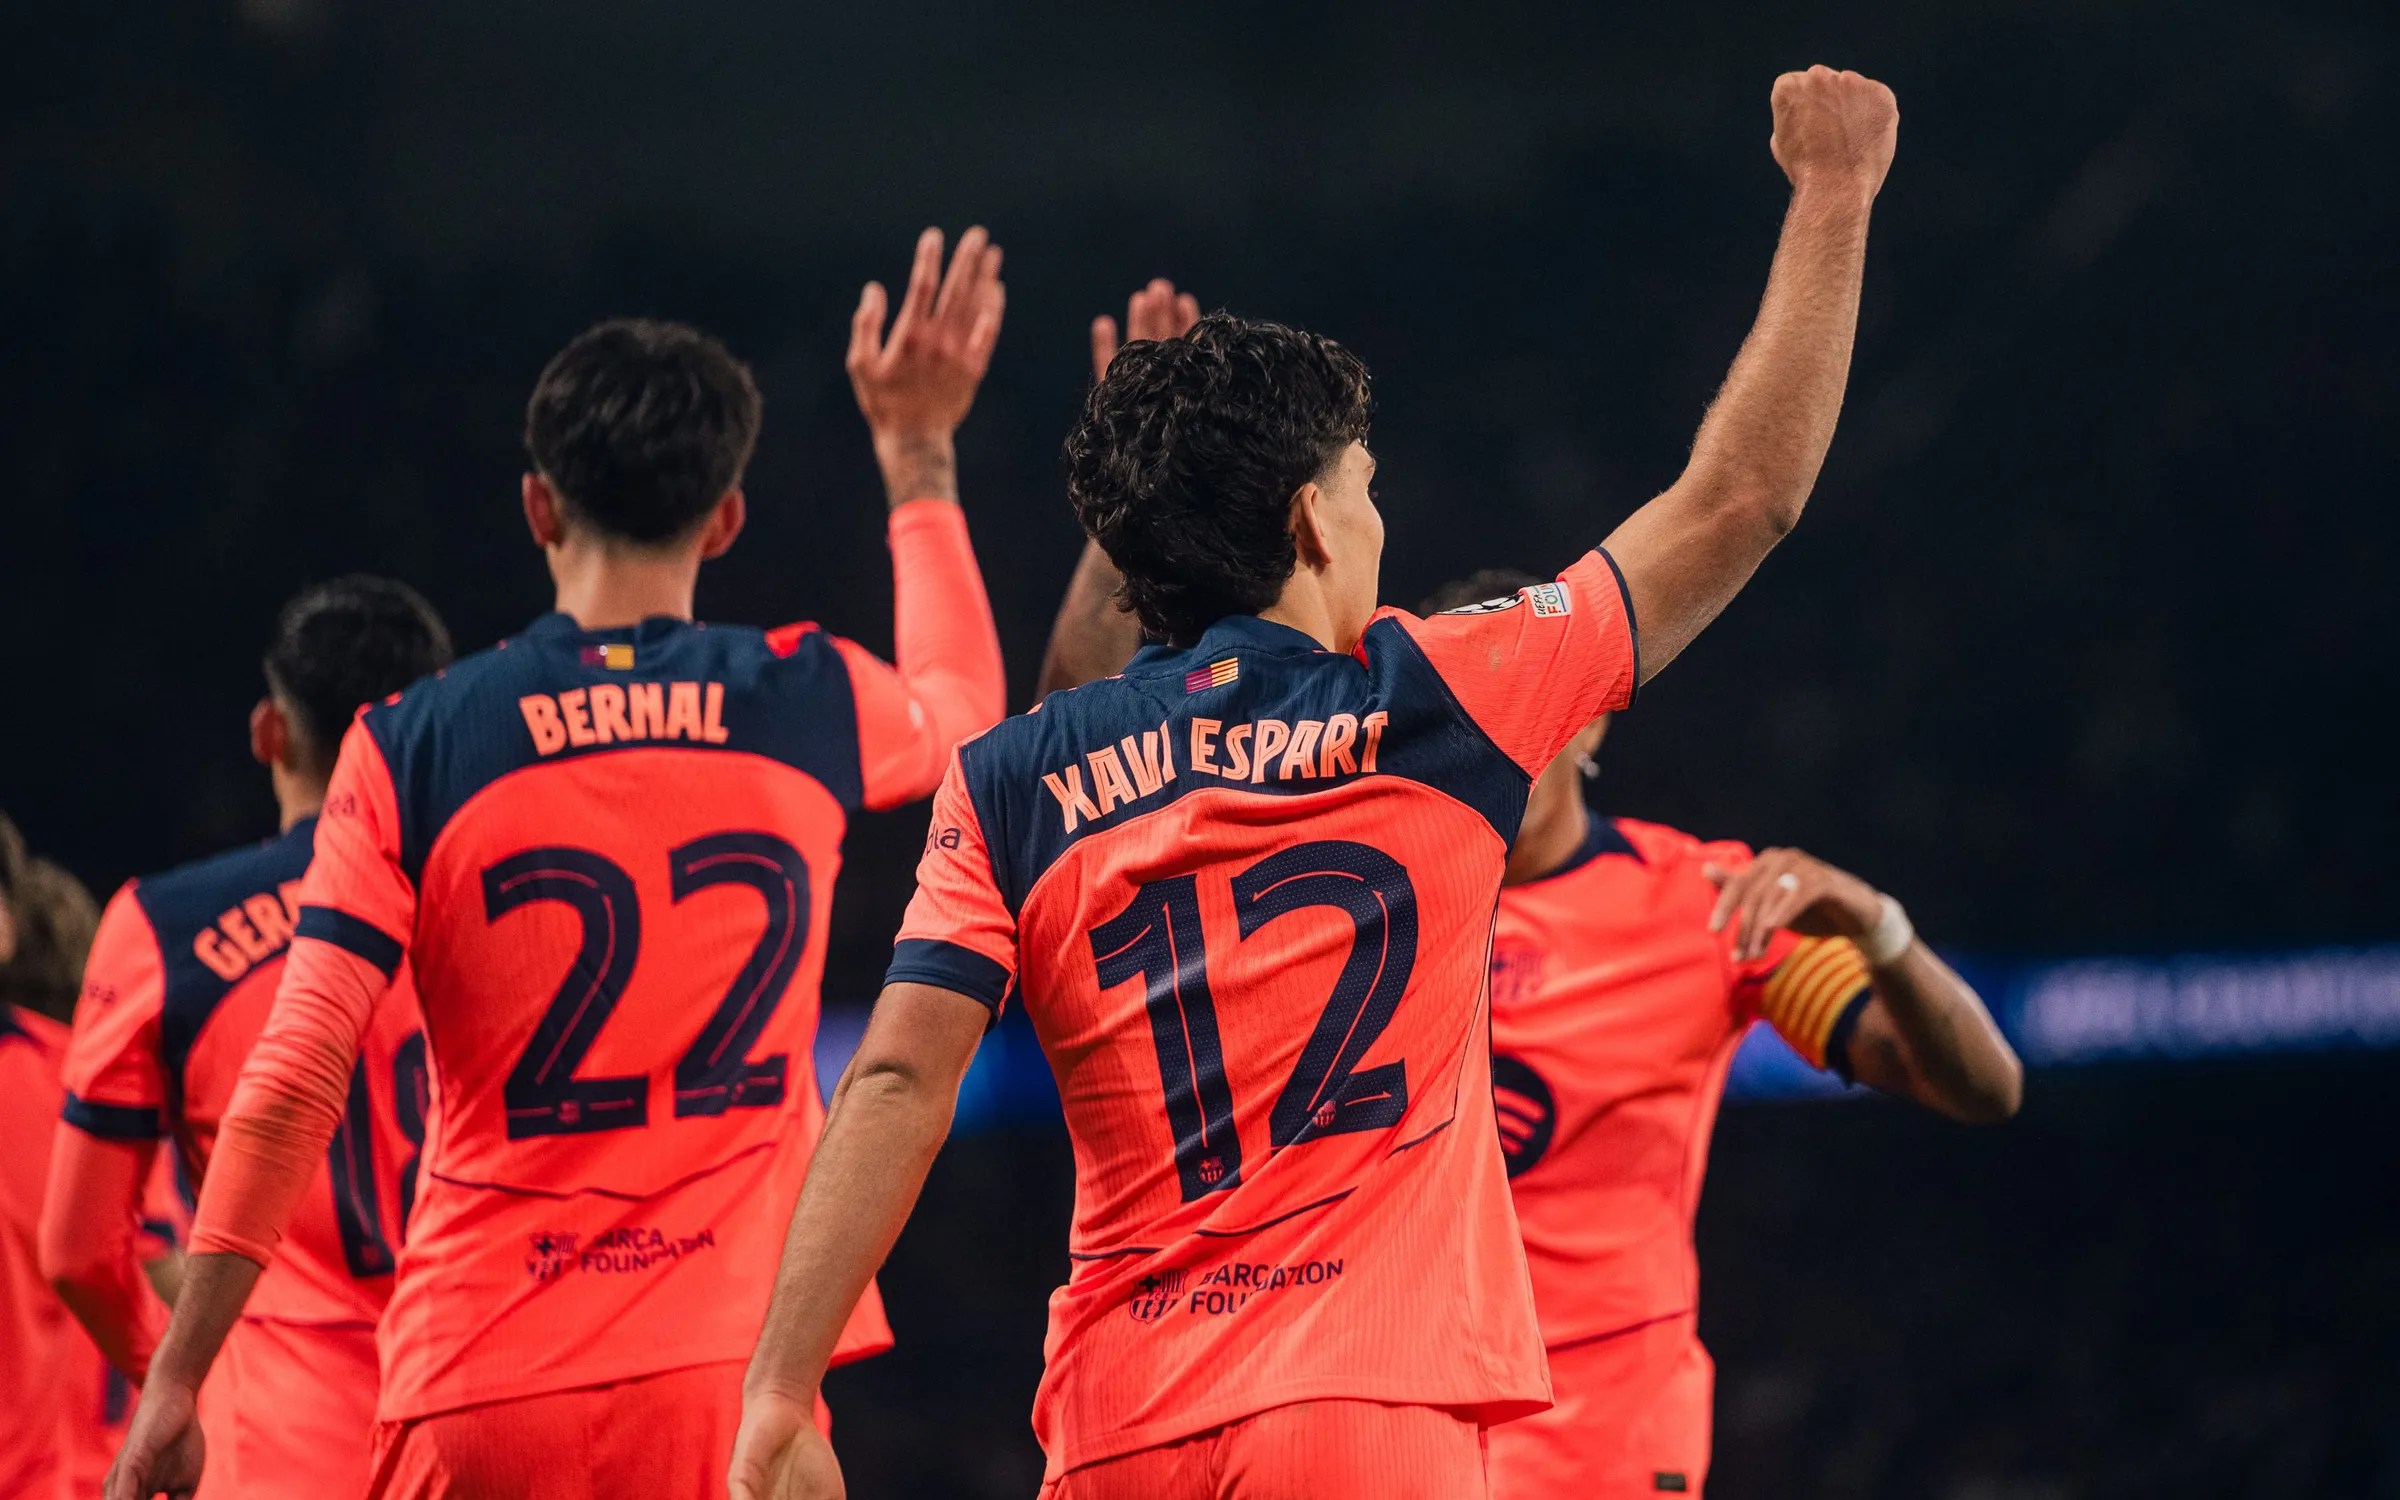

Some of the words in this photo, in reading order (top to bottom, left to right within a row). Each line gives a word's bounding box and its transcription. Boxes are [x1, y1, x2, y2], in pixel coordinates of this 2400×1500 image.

[1533, 594, 1546, 615] UEFA
[519, 681, 729, 756] BERNAL
[1042, 720, 1177, 834] XAVI
[1191, 710, 1389, 784] ESPART
[481, 829, 812, 1140] 22
[1088, 839, 1419, 1204] 12
